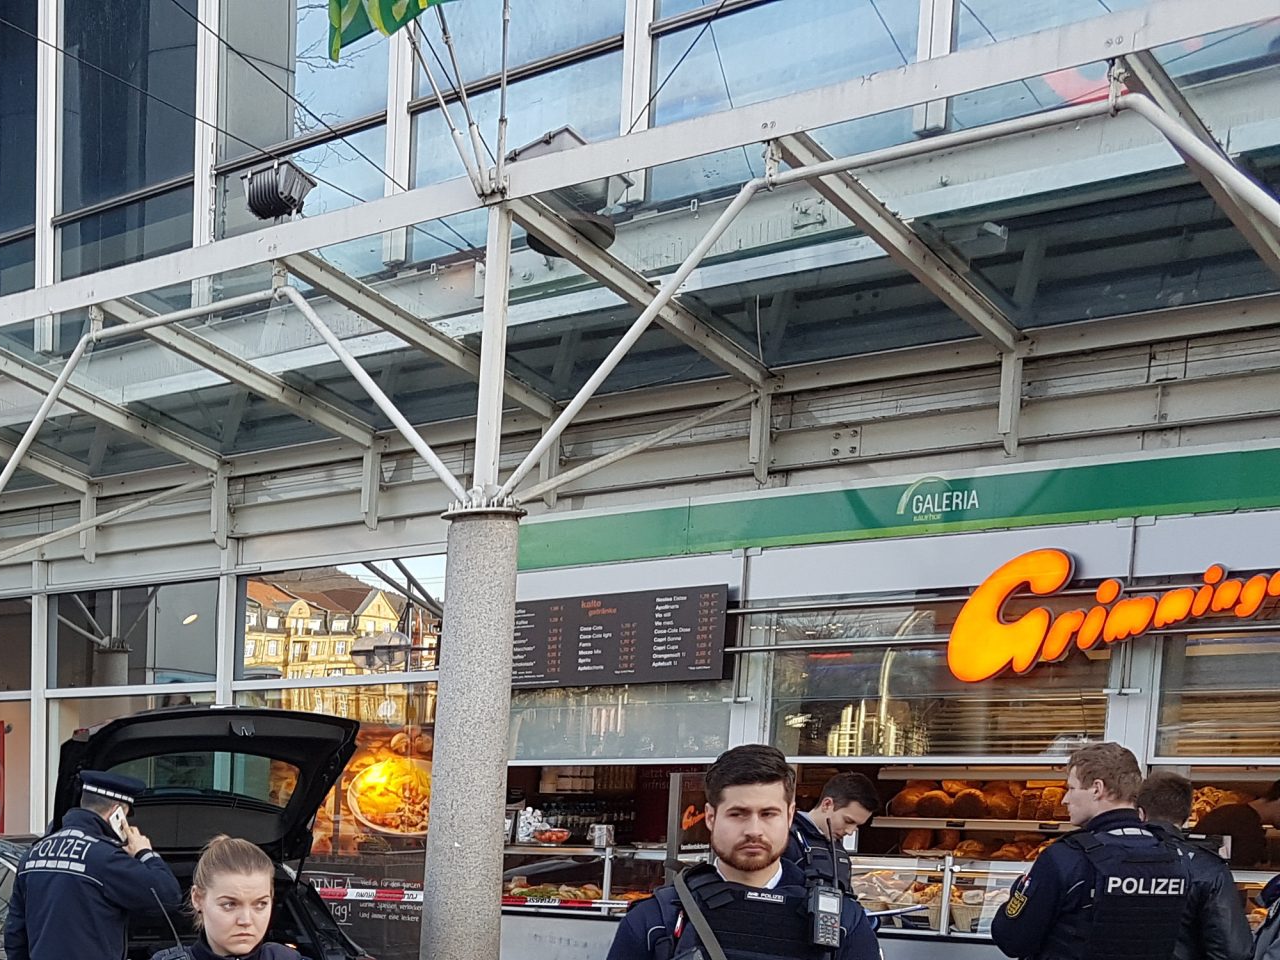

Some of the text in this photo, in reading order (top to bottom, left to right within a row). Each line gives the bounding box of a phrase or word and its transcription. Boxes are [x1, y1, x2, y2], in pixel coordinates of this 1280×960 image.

[911, 490, 980, 514] GALERIA
[29, 838, 92, 861] POLIZEI
[1107, 876, 1185, 895] POLIZEI
[760, 892, 784, 900] POLIZEI
[328, 902, 352, 922] Tag!
